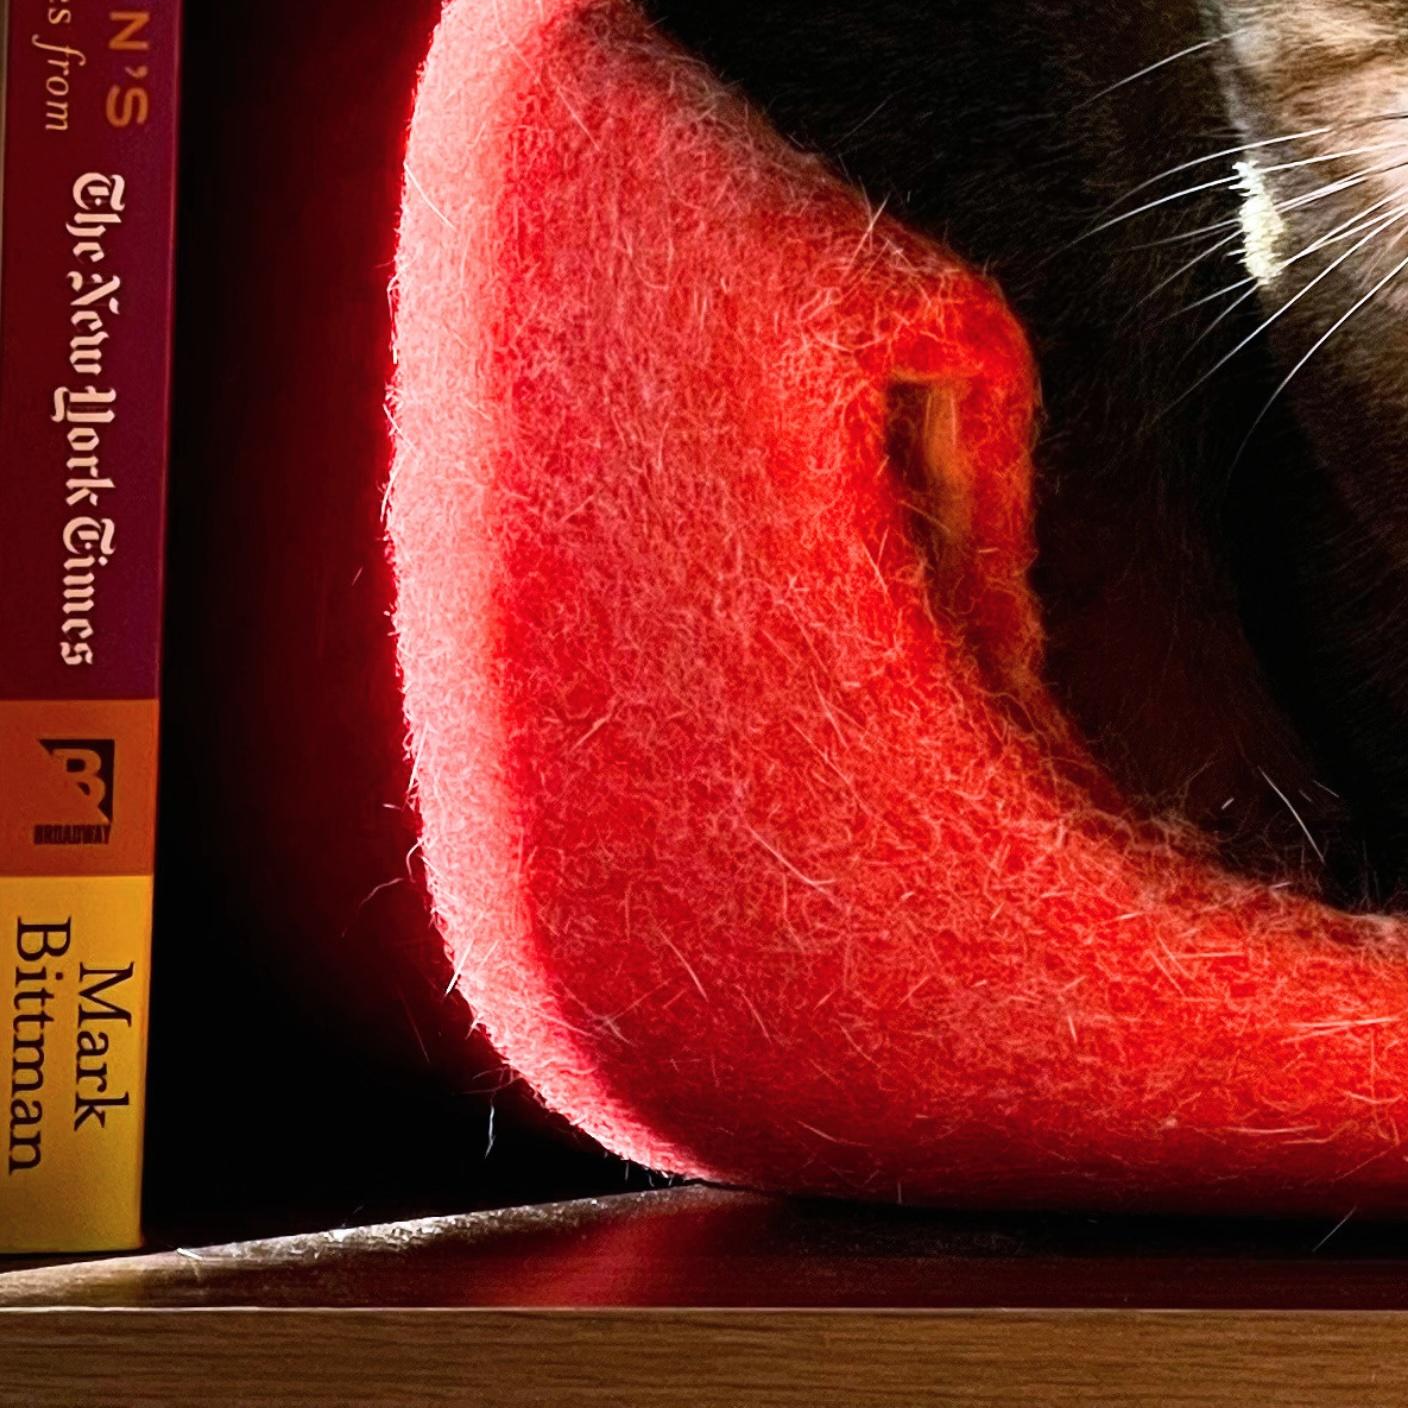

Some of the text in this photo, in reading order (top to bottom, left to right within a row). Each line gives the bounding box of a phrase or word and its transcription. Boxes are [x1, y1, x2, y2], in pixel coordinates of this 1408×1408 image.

[31, 34, 86, 132] from
[50, 172, 125, 666] The New York Times
[8, 916, 71, 1176] Bittman
[74, 961, 134, 1132] Mark
